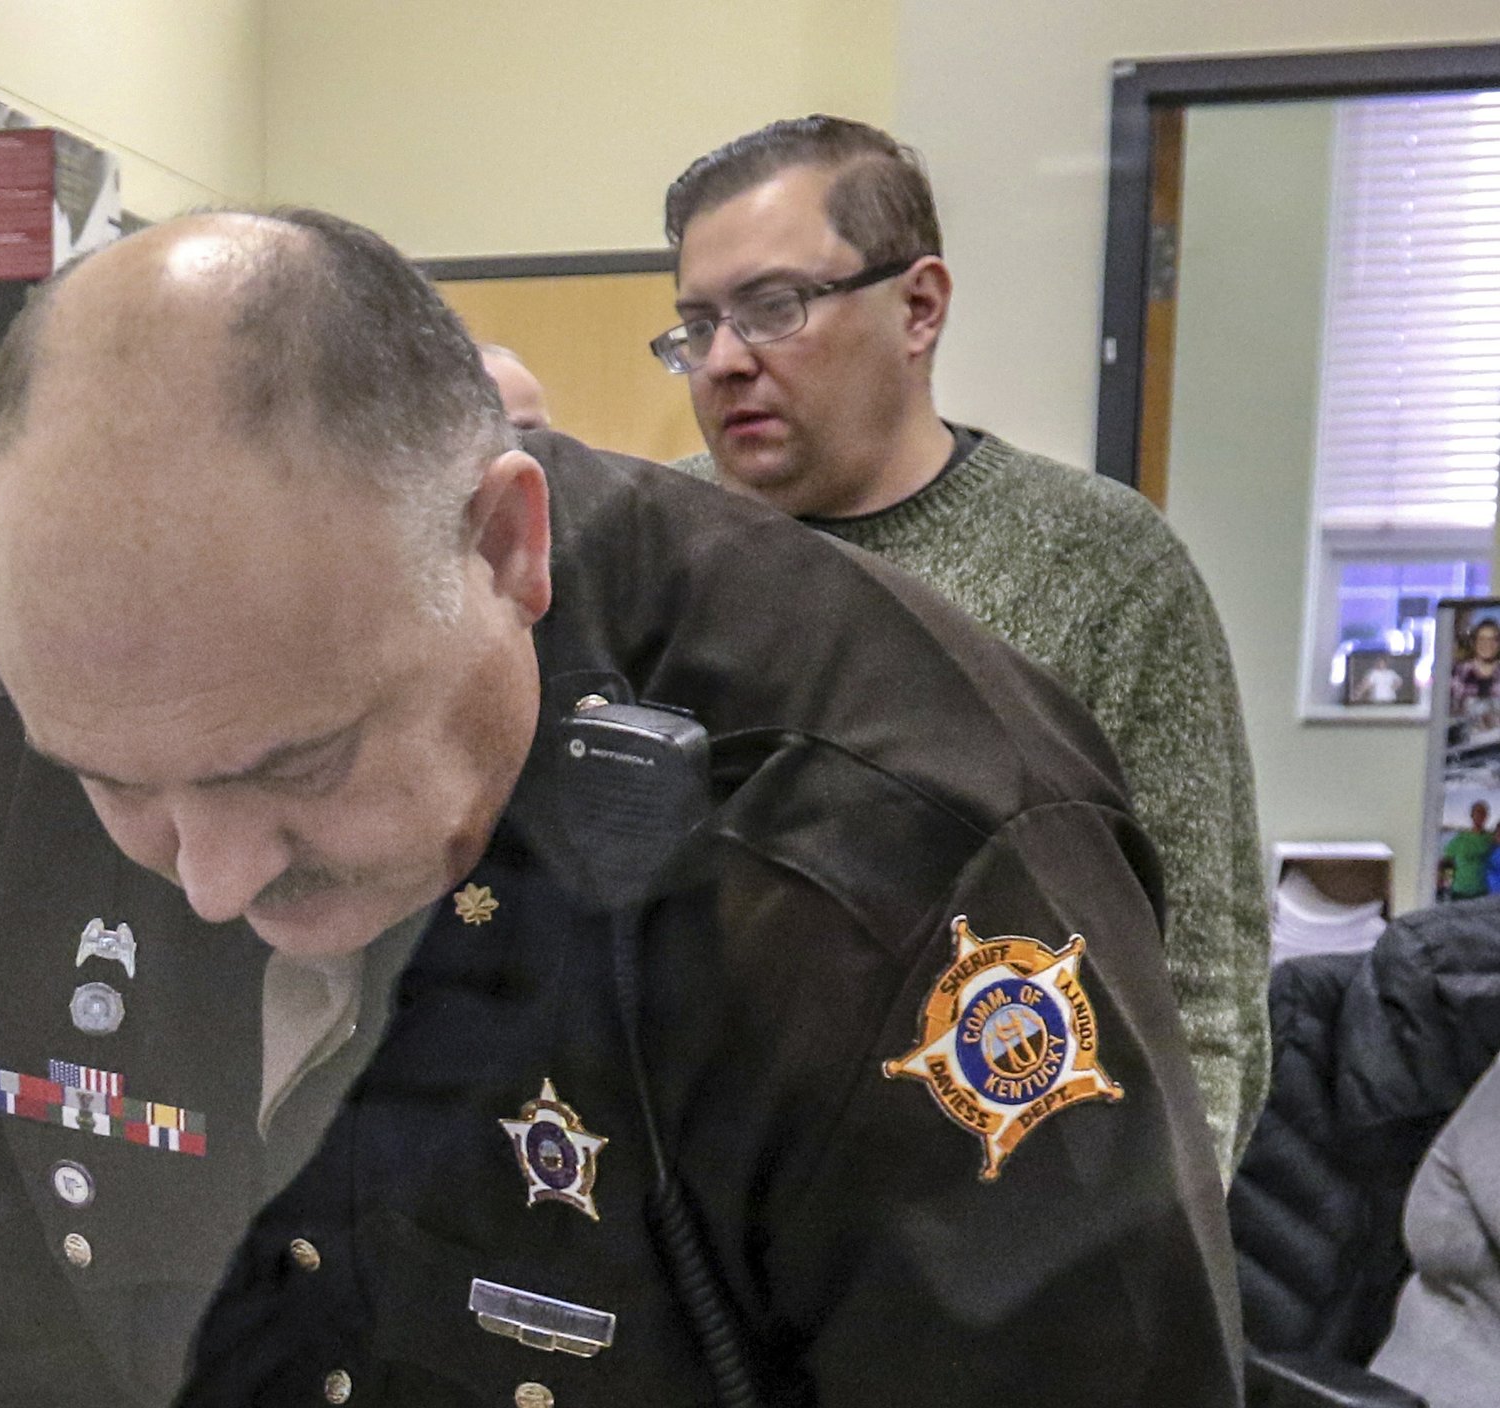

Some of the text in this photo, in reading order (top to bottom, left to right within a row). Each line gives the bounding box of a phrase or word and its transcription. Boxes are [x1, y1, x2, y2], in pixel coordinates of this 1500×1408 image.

[940, 944, 1011, 998] SHERIFF
[1019, 985, 1045, 1006] OF
[1060, 980, 1094, 1052] COUNTY
[928, 1058, 990, 1129] DAVIESS
[983, 1034, 1066, 1099] KENTUCKY
